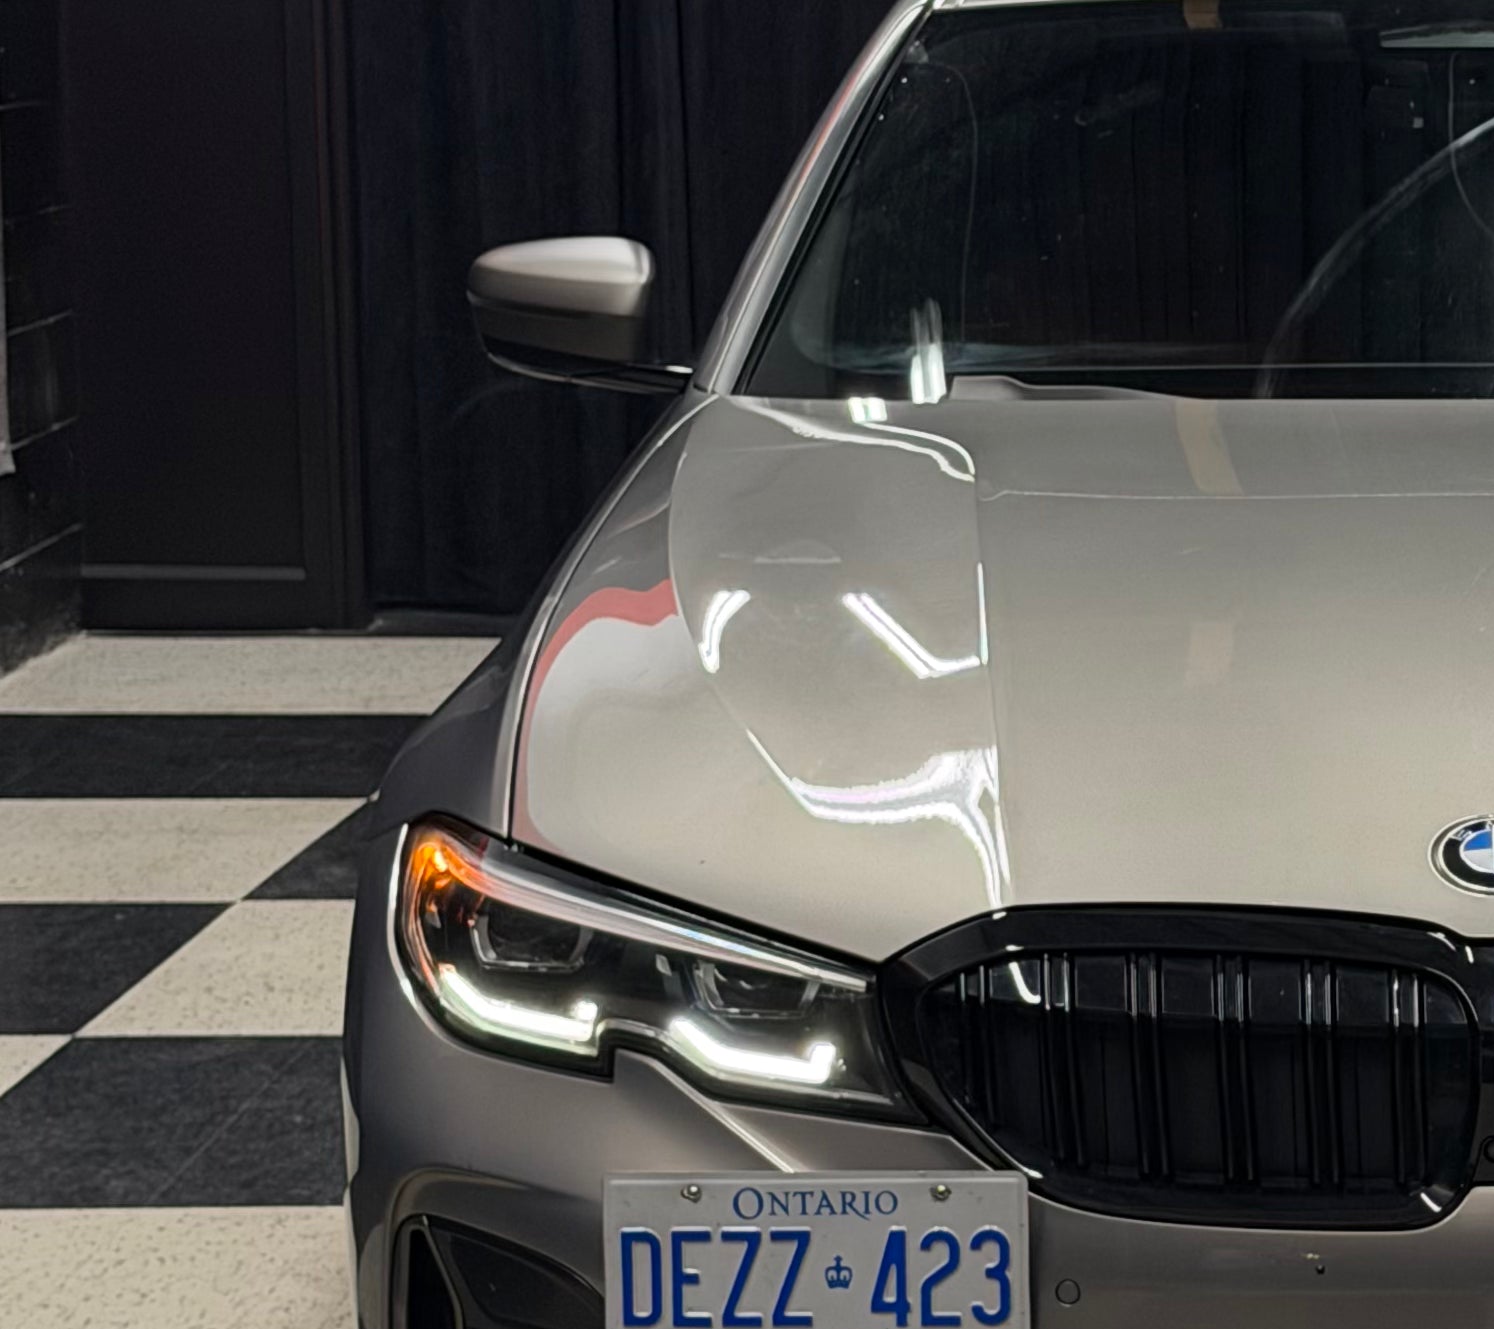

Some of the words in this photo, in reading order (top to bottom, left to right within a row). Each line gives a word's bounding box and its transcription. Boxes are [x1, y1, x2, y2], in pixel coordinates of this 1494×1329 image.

[733, 1187, 898, 1220] ONTARIO
[620, 1226, 813, 1328] DEZZ
[870, 1225, 1011, 1328] 423
